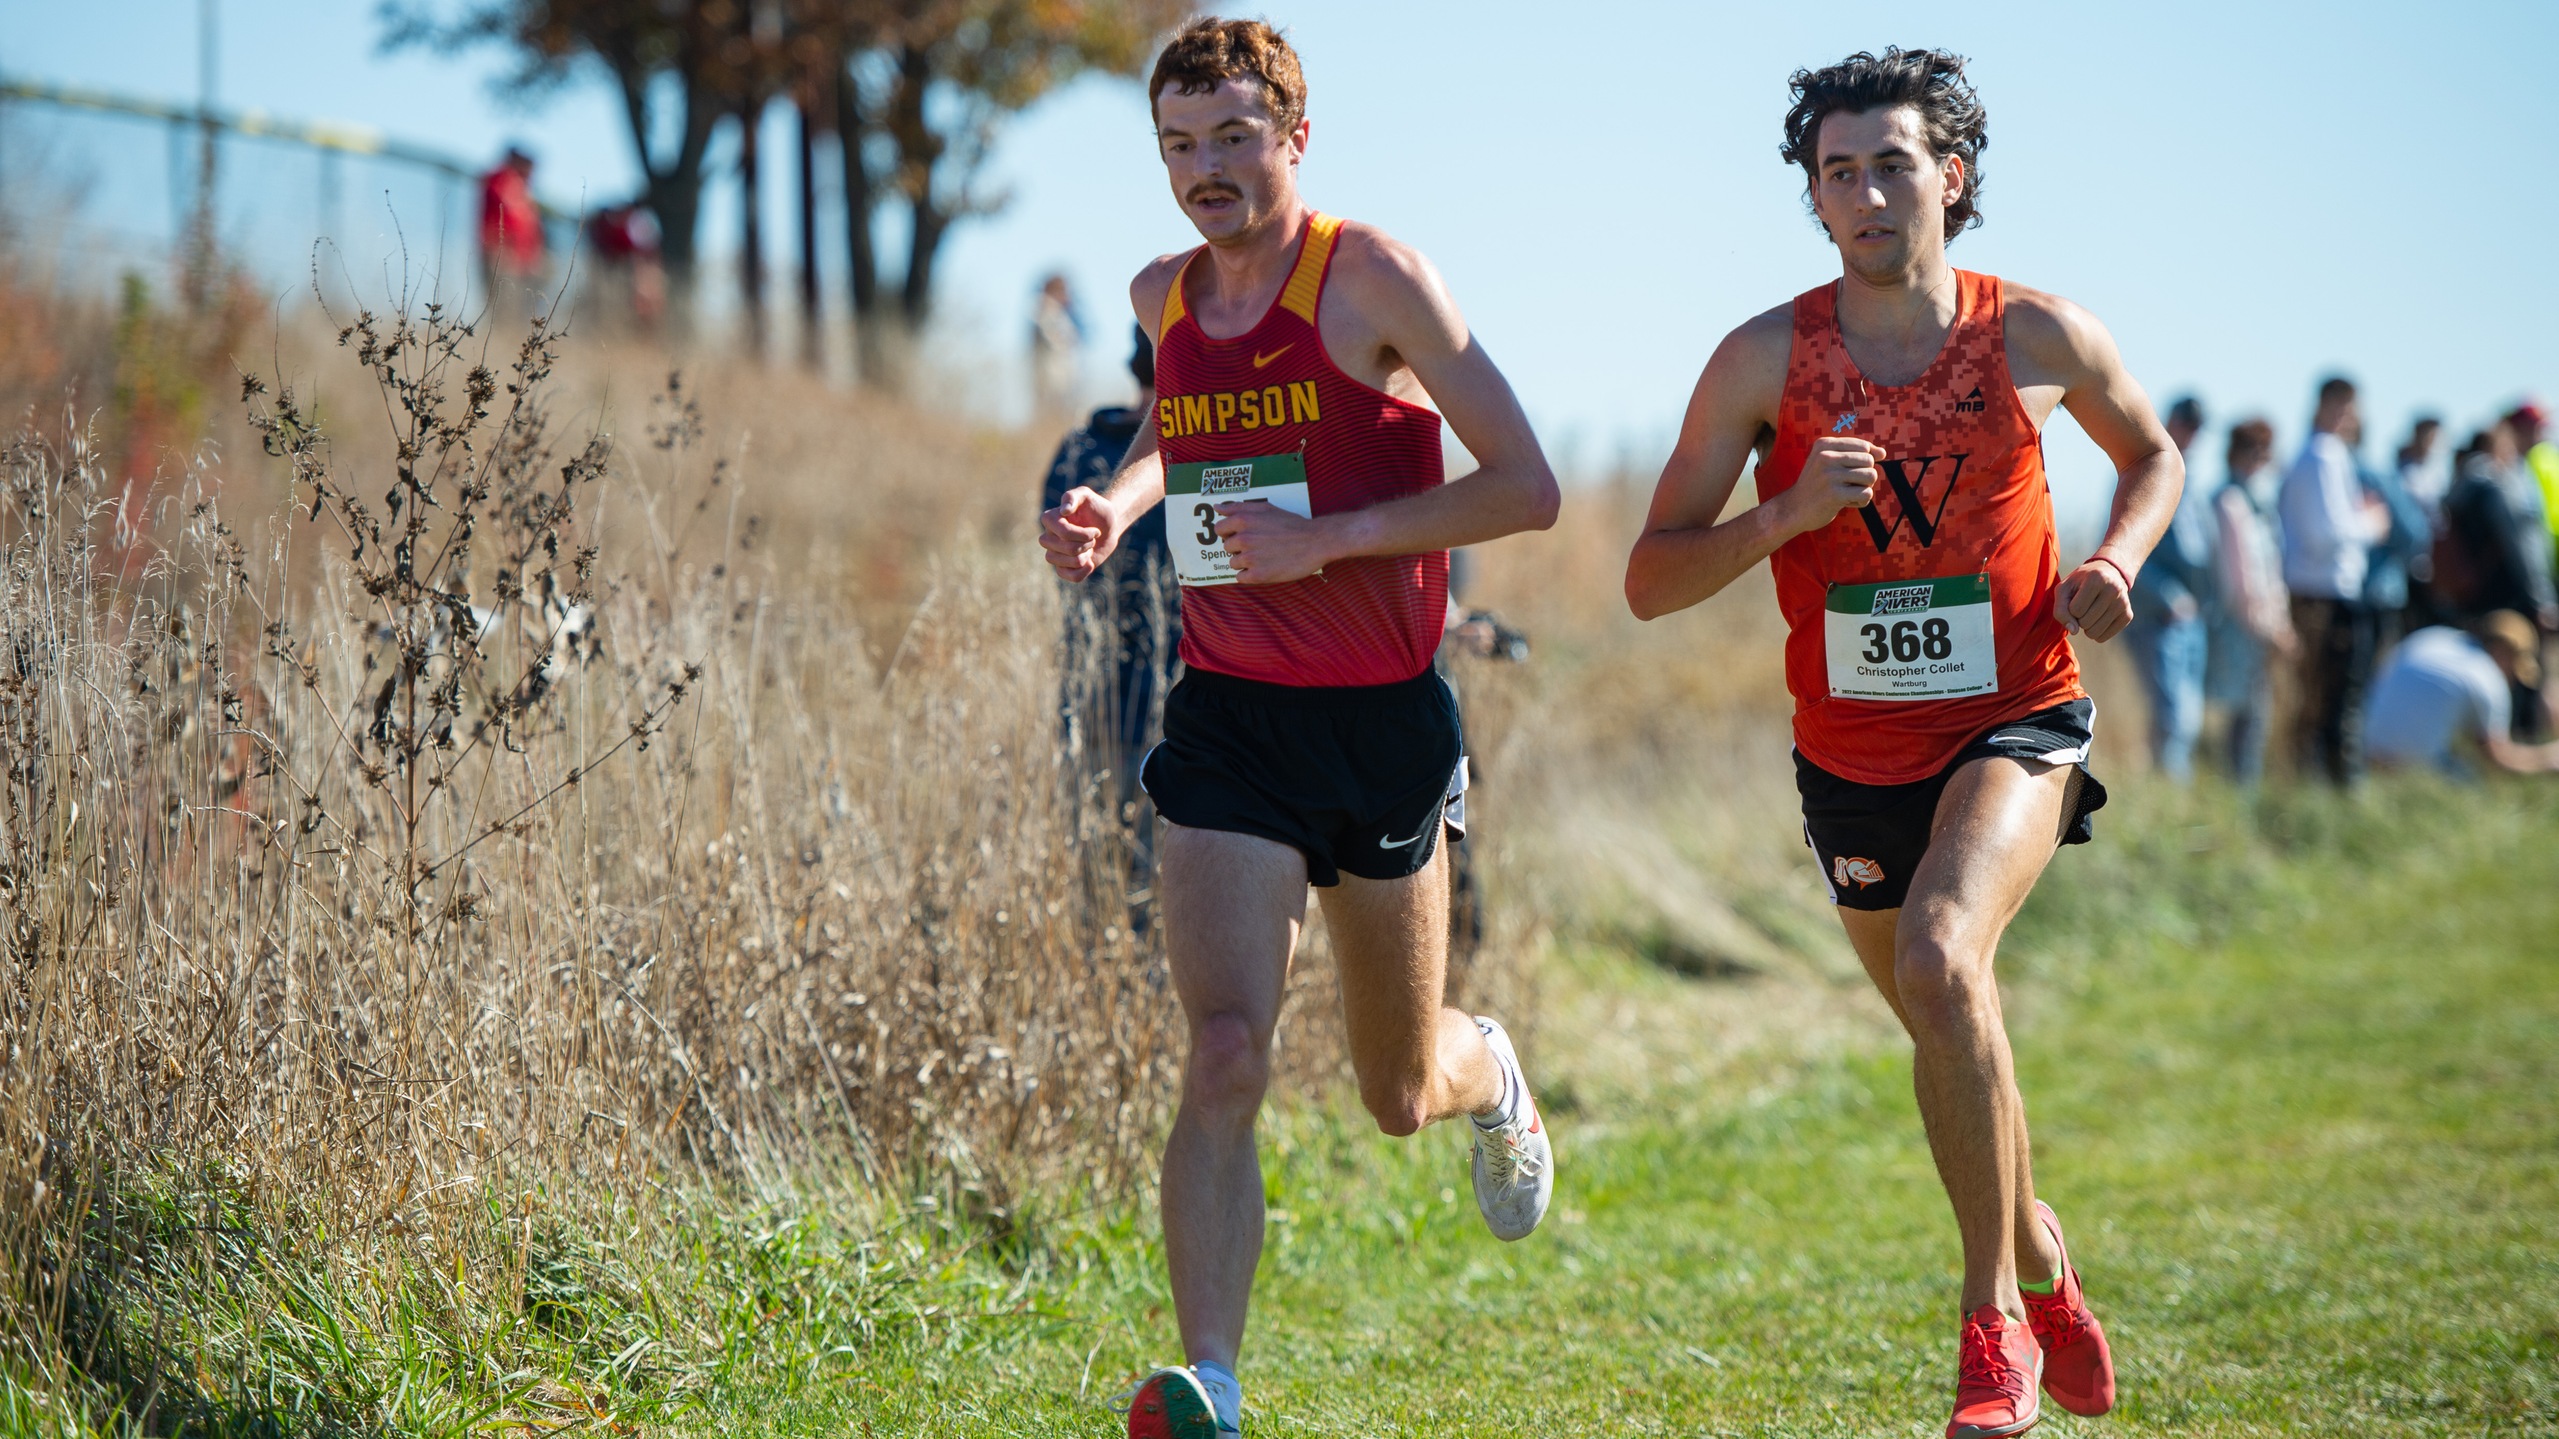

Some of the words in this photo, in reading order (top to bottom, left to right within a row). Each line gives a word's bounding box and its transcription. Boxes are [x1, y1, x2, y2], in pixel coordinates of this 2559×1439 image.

[1159, 380, 1321, 439] SIMPSON
[1204, 466, 1251, 478] AMERICAN
[1202, 476, 1249, 494] RIVERS
[1858, 453, 1970, 553] W
[1213, 563, 1232, 571] Simp
[1876, 587, 1931, 599] AMERICAN
[1873, 596, 1929, 615] RIVERS
[1860, 617, 1952, 664] 368
[1857, 665, 1926, 678] Christopher
[1929, 662, 1965, 674] Collet
[1892, 680, 1927, 688] Wartburg
